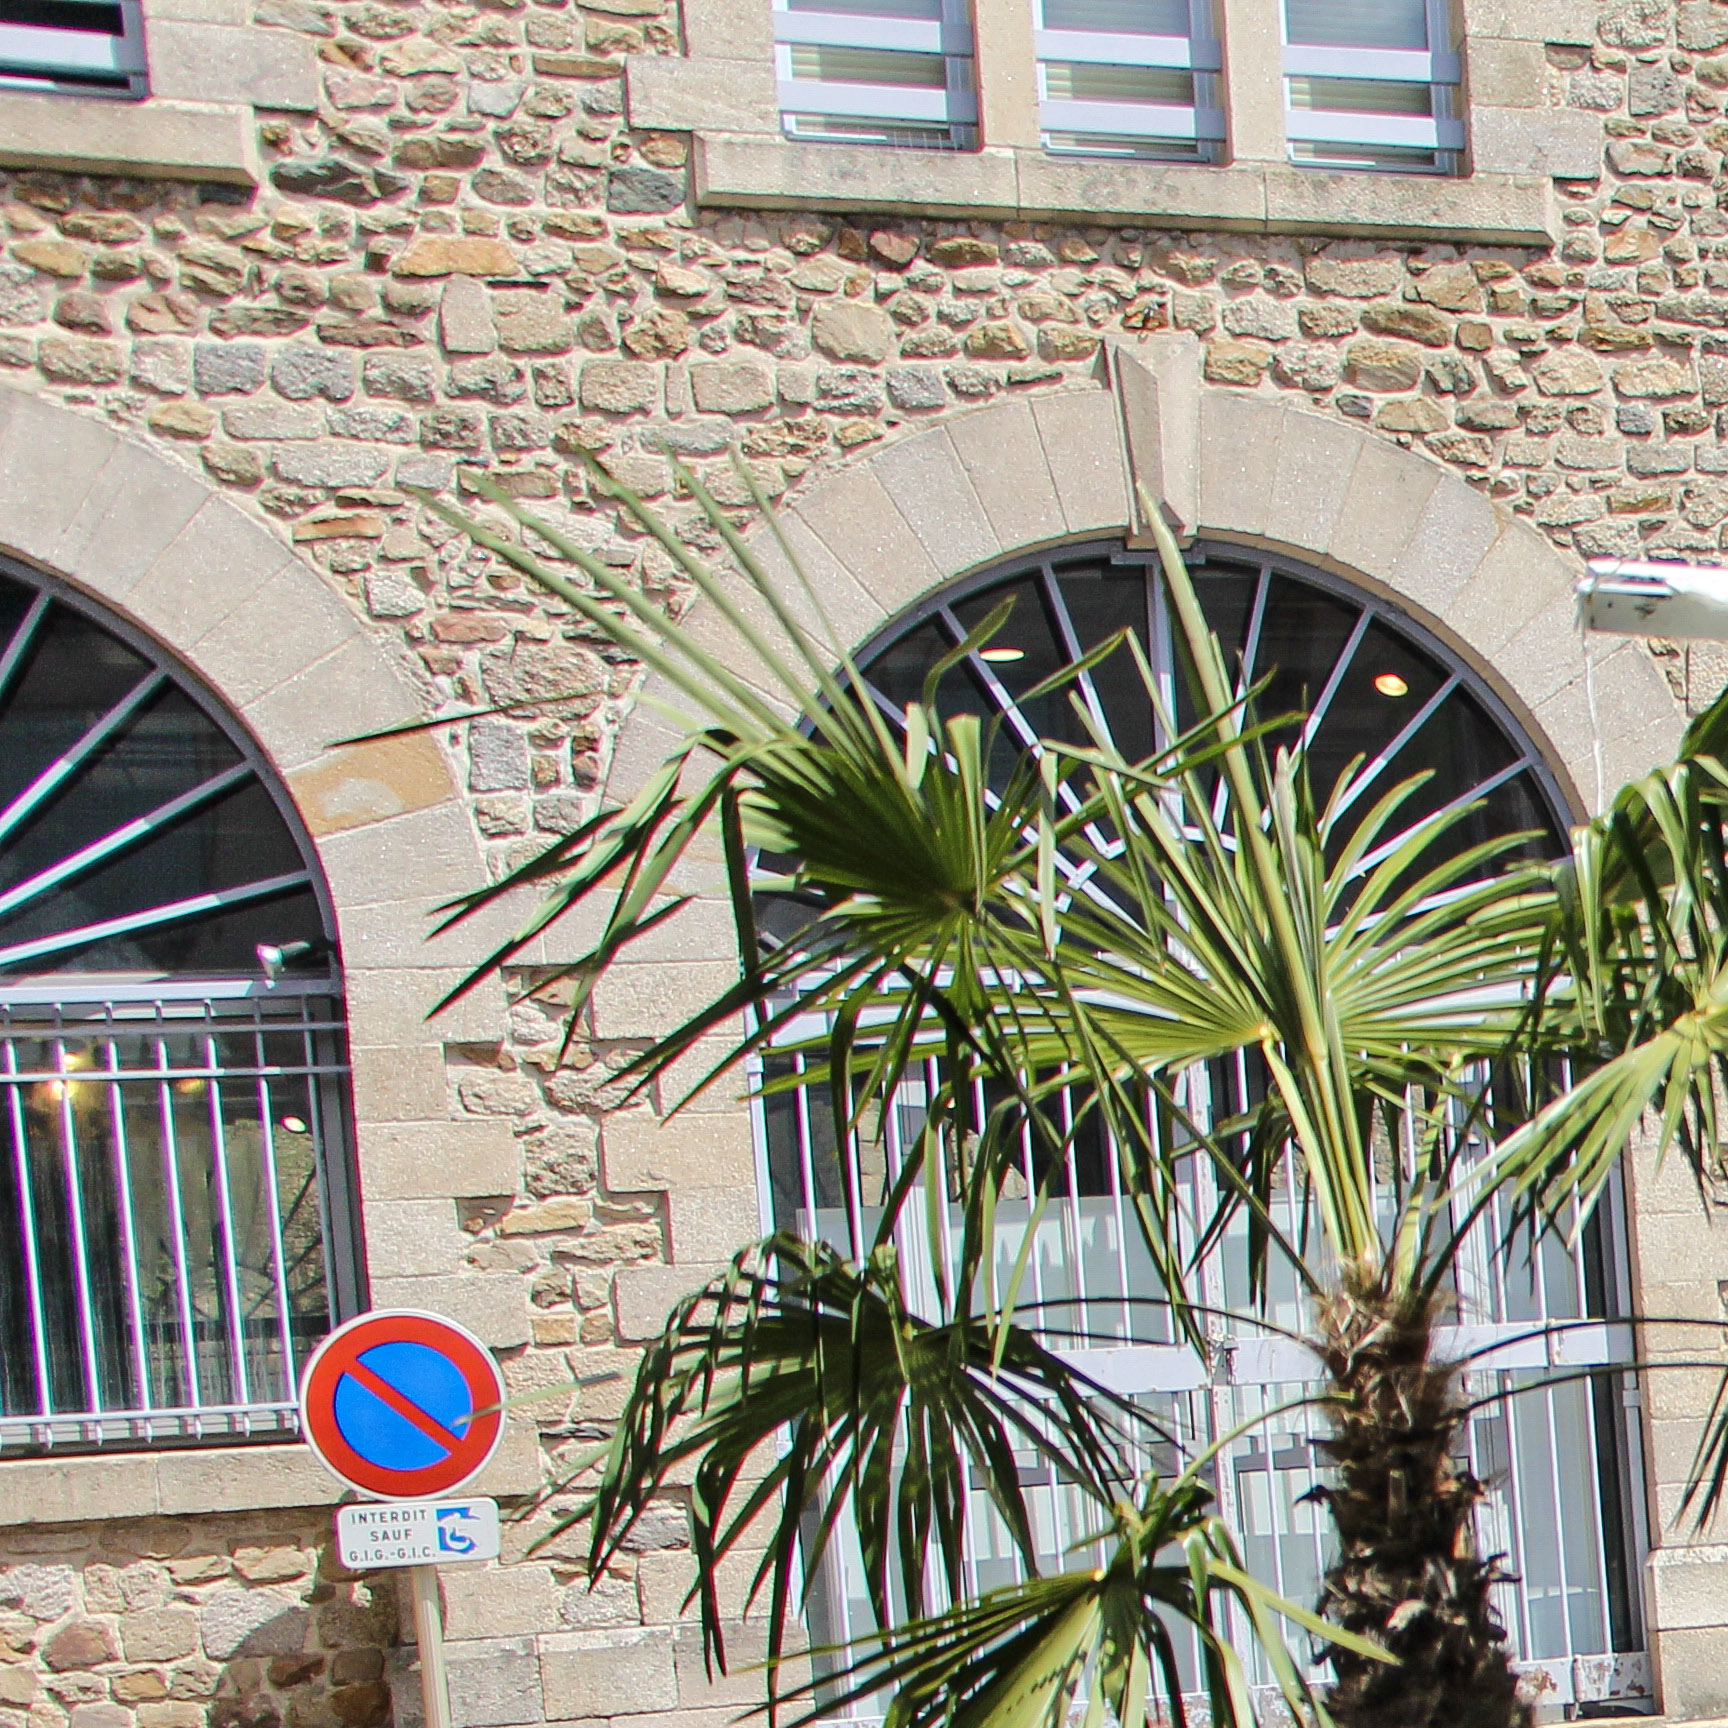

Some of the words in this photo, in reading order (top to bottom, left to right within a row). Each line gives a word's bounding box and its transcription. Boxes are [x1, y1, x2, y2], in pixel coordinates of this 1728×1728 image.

[351, 1509, 428, 1525] INTERDIT
[370, 1528, 413, 1543] SAUF
[349, 1546, 437, 1562] G.I.G.-G.I.C.
